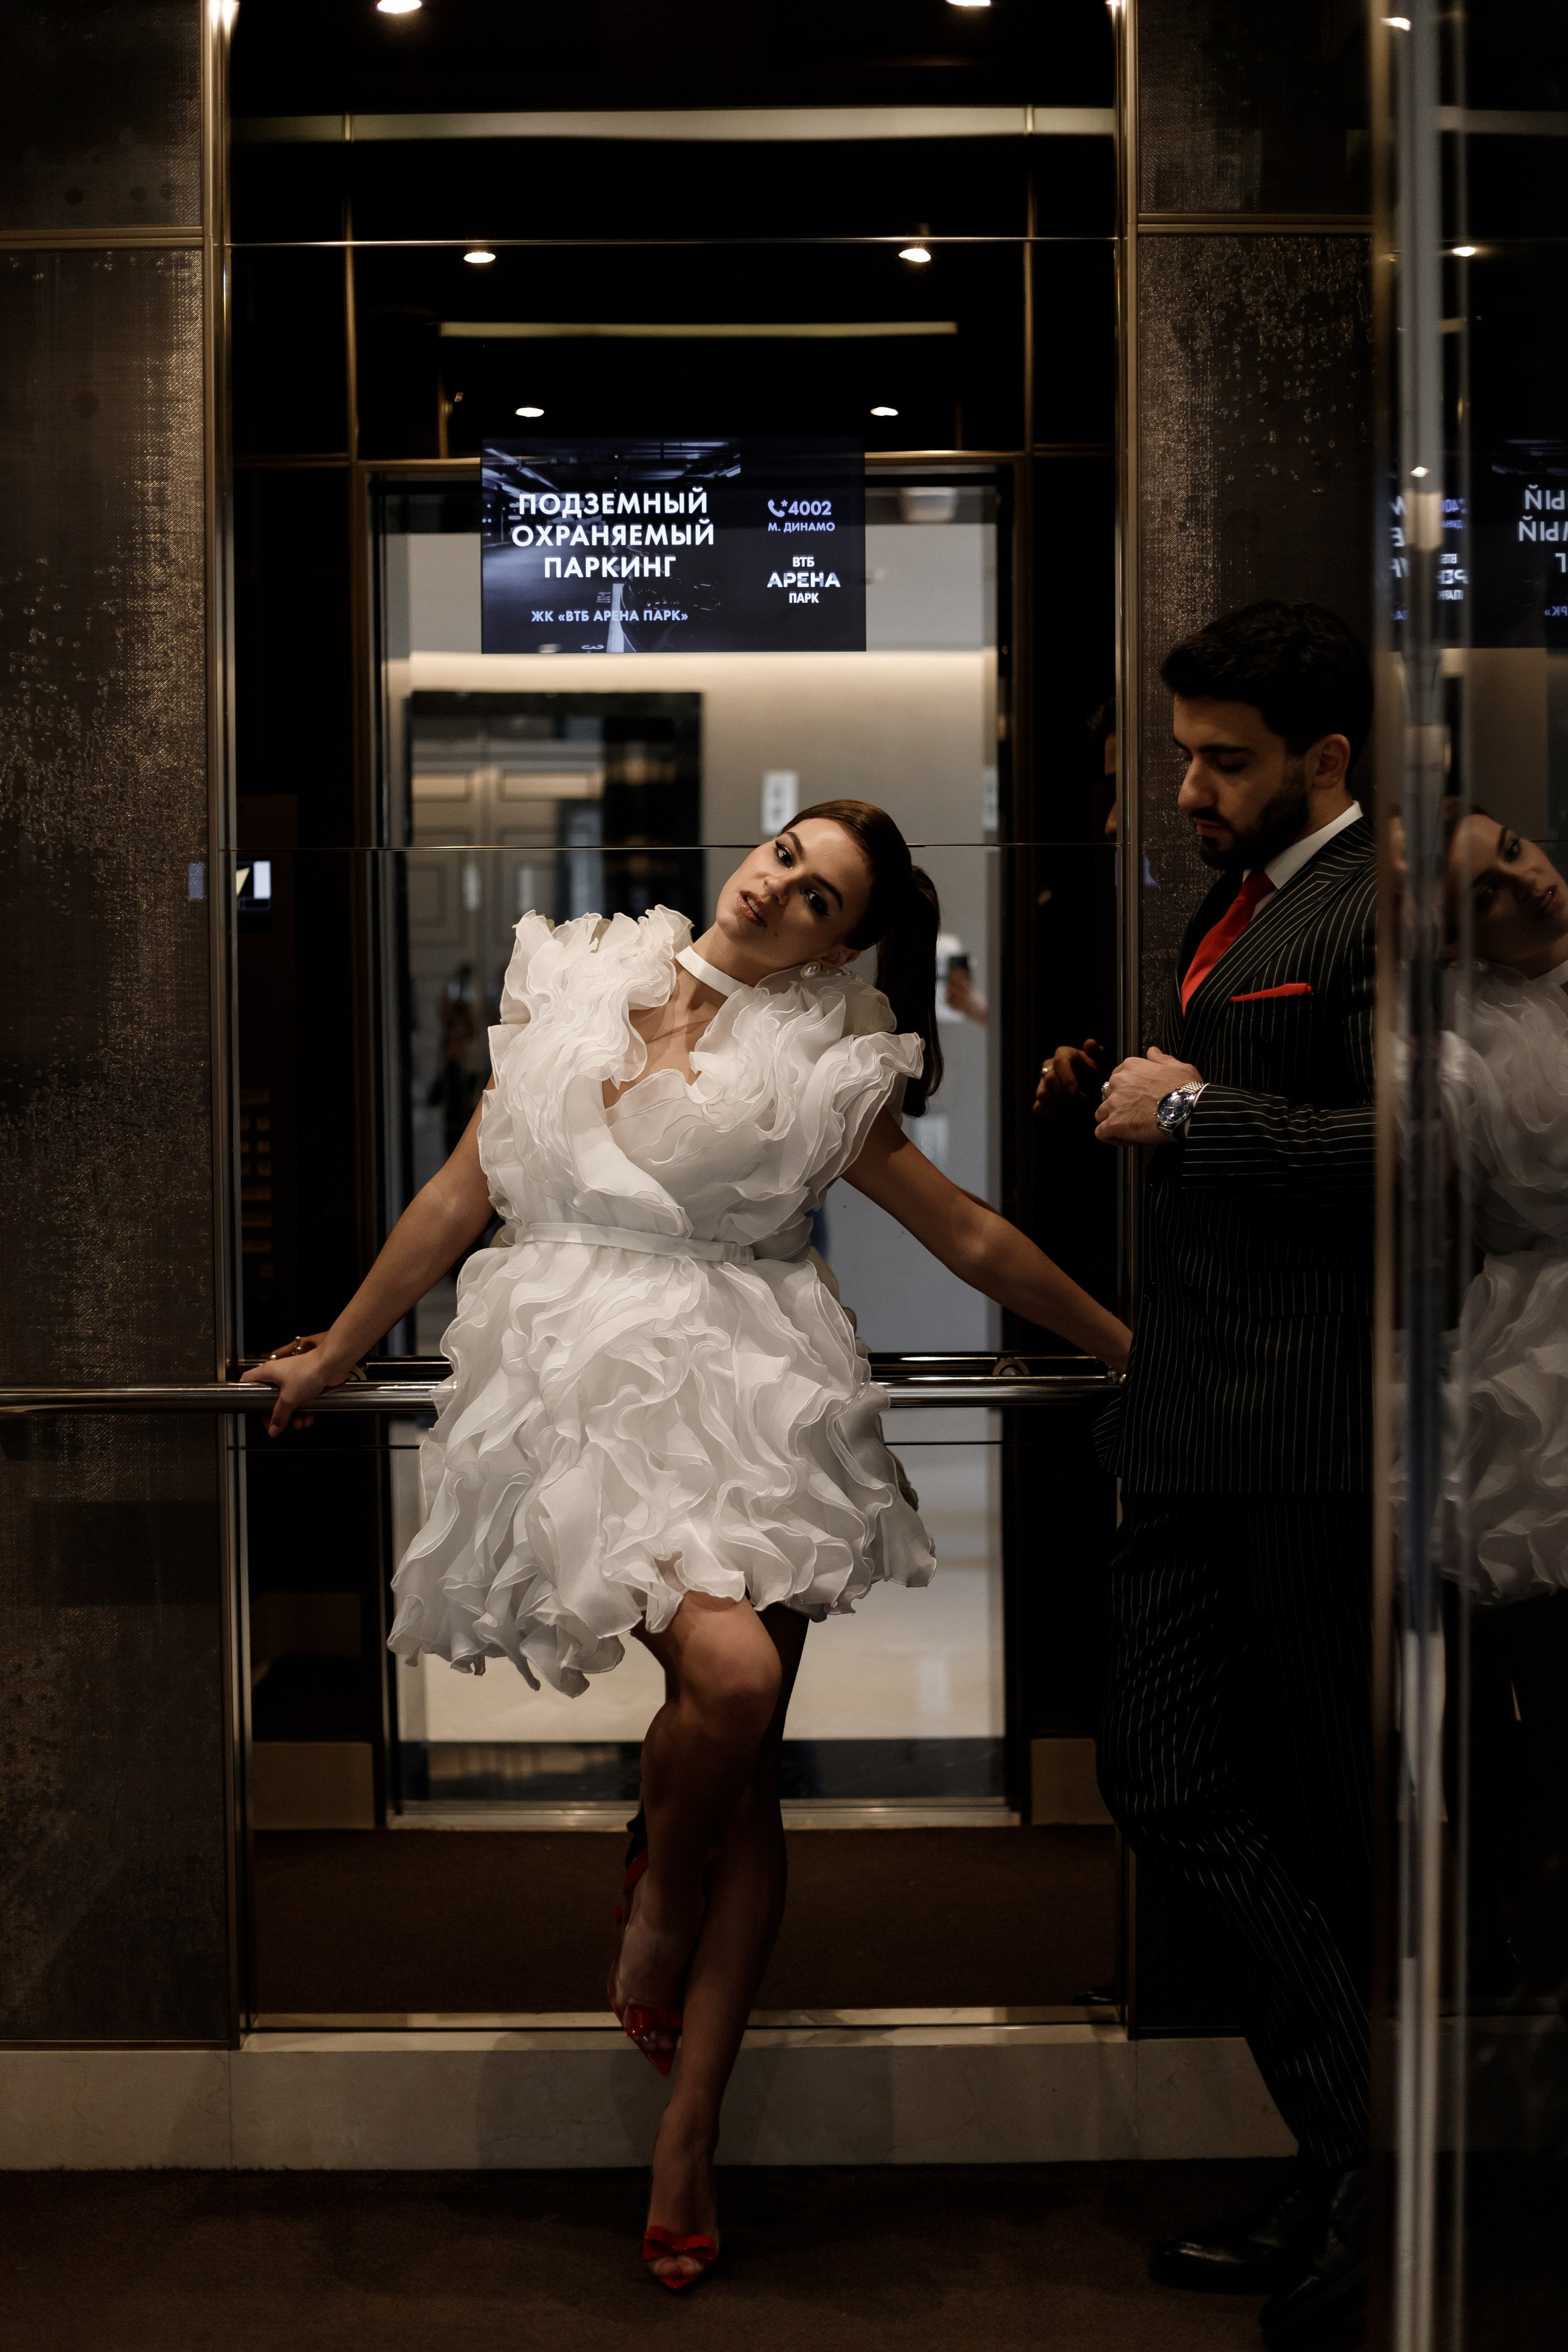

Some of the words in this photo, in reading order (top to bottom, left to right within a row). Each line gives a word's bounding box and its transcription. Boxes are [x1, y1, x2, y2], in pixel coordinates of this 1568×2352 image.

[519, 487, 707, 518] ПОДЗЕМНЫЙ
[511, 519, 714, 547] ОХРАНЯЕМЫЙ
[767, 522, 781, 532] М.
[783, 522, 835, 533] ДИНАМО
[544, 556, 676, 578] ПАРКИНГ
[793, 556, 815, 567] ВТБ
[767, 572, 841, 587] АРЕНА
[789, 592, 820, 603] ПАРК
[531, 611, 554, 622] ЖК
[558, 610, 590, 622] «ВТБ
[593, 610, 639, 622] АРЕНА
[643, 610, 688, 622] ПАРК»
